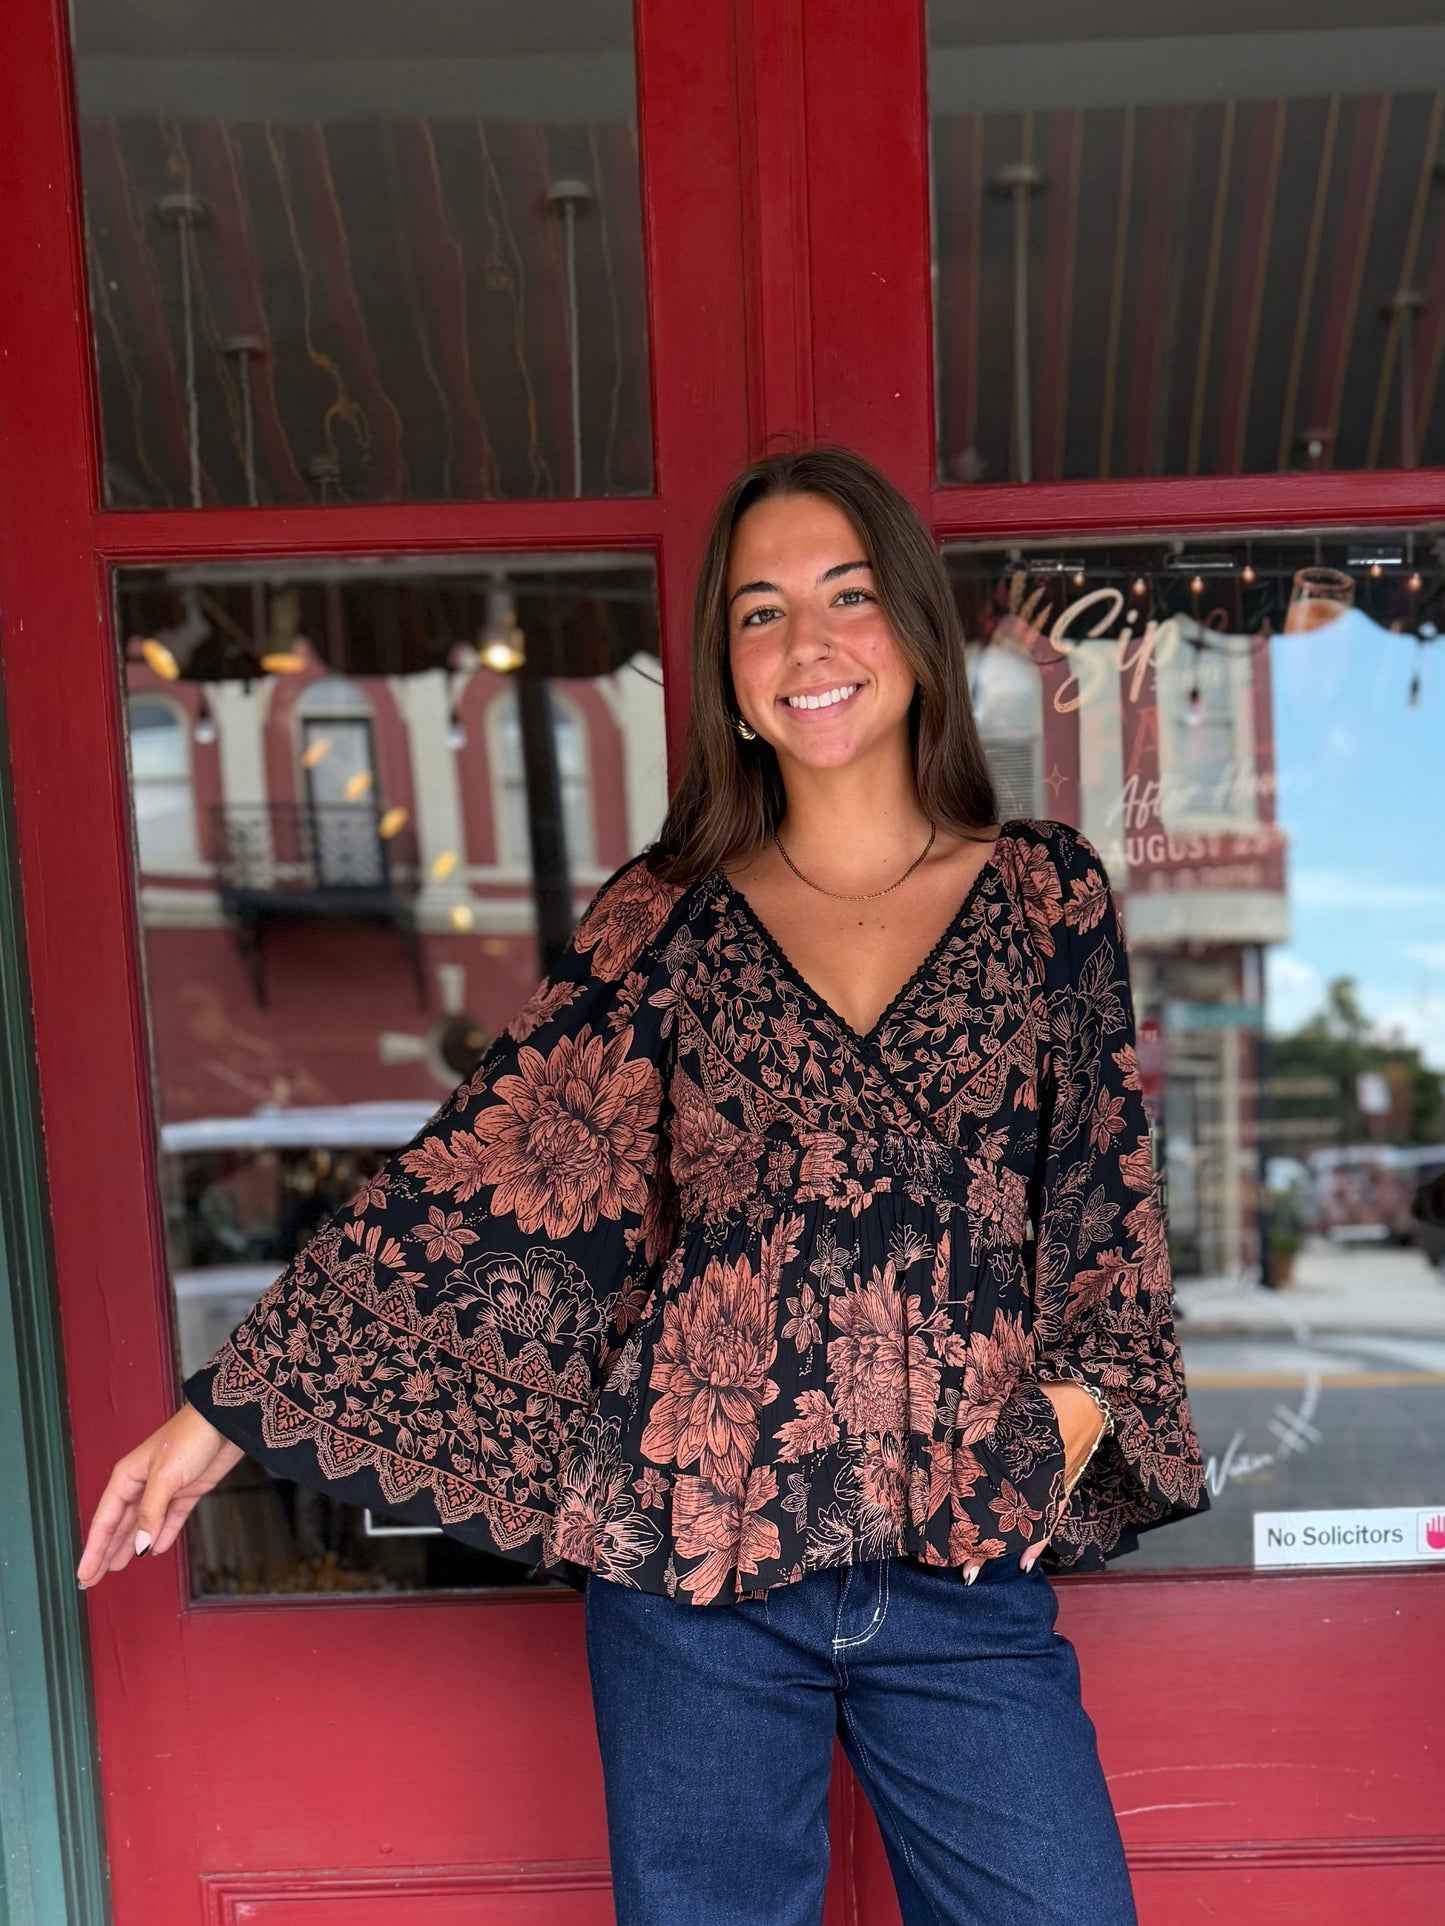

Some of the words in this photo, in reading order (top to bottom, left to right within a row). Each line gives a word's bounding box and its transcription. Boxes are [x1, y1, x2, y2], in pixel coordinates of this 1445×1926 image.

[1050, 588, 1180, 713] Sip
[1104, 774, 1200, 829] Aft
[1107, 832, 1223, 866] AUGUST
[1267, 1527, 1296, 1547] No
[1302, 1525, 1404, 1546] Solicitors
